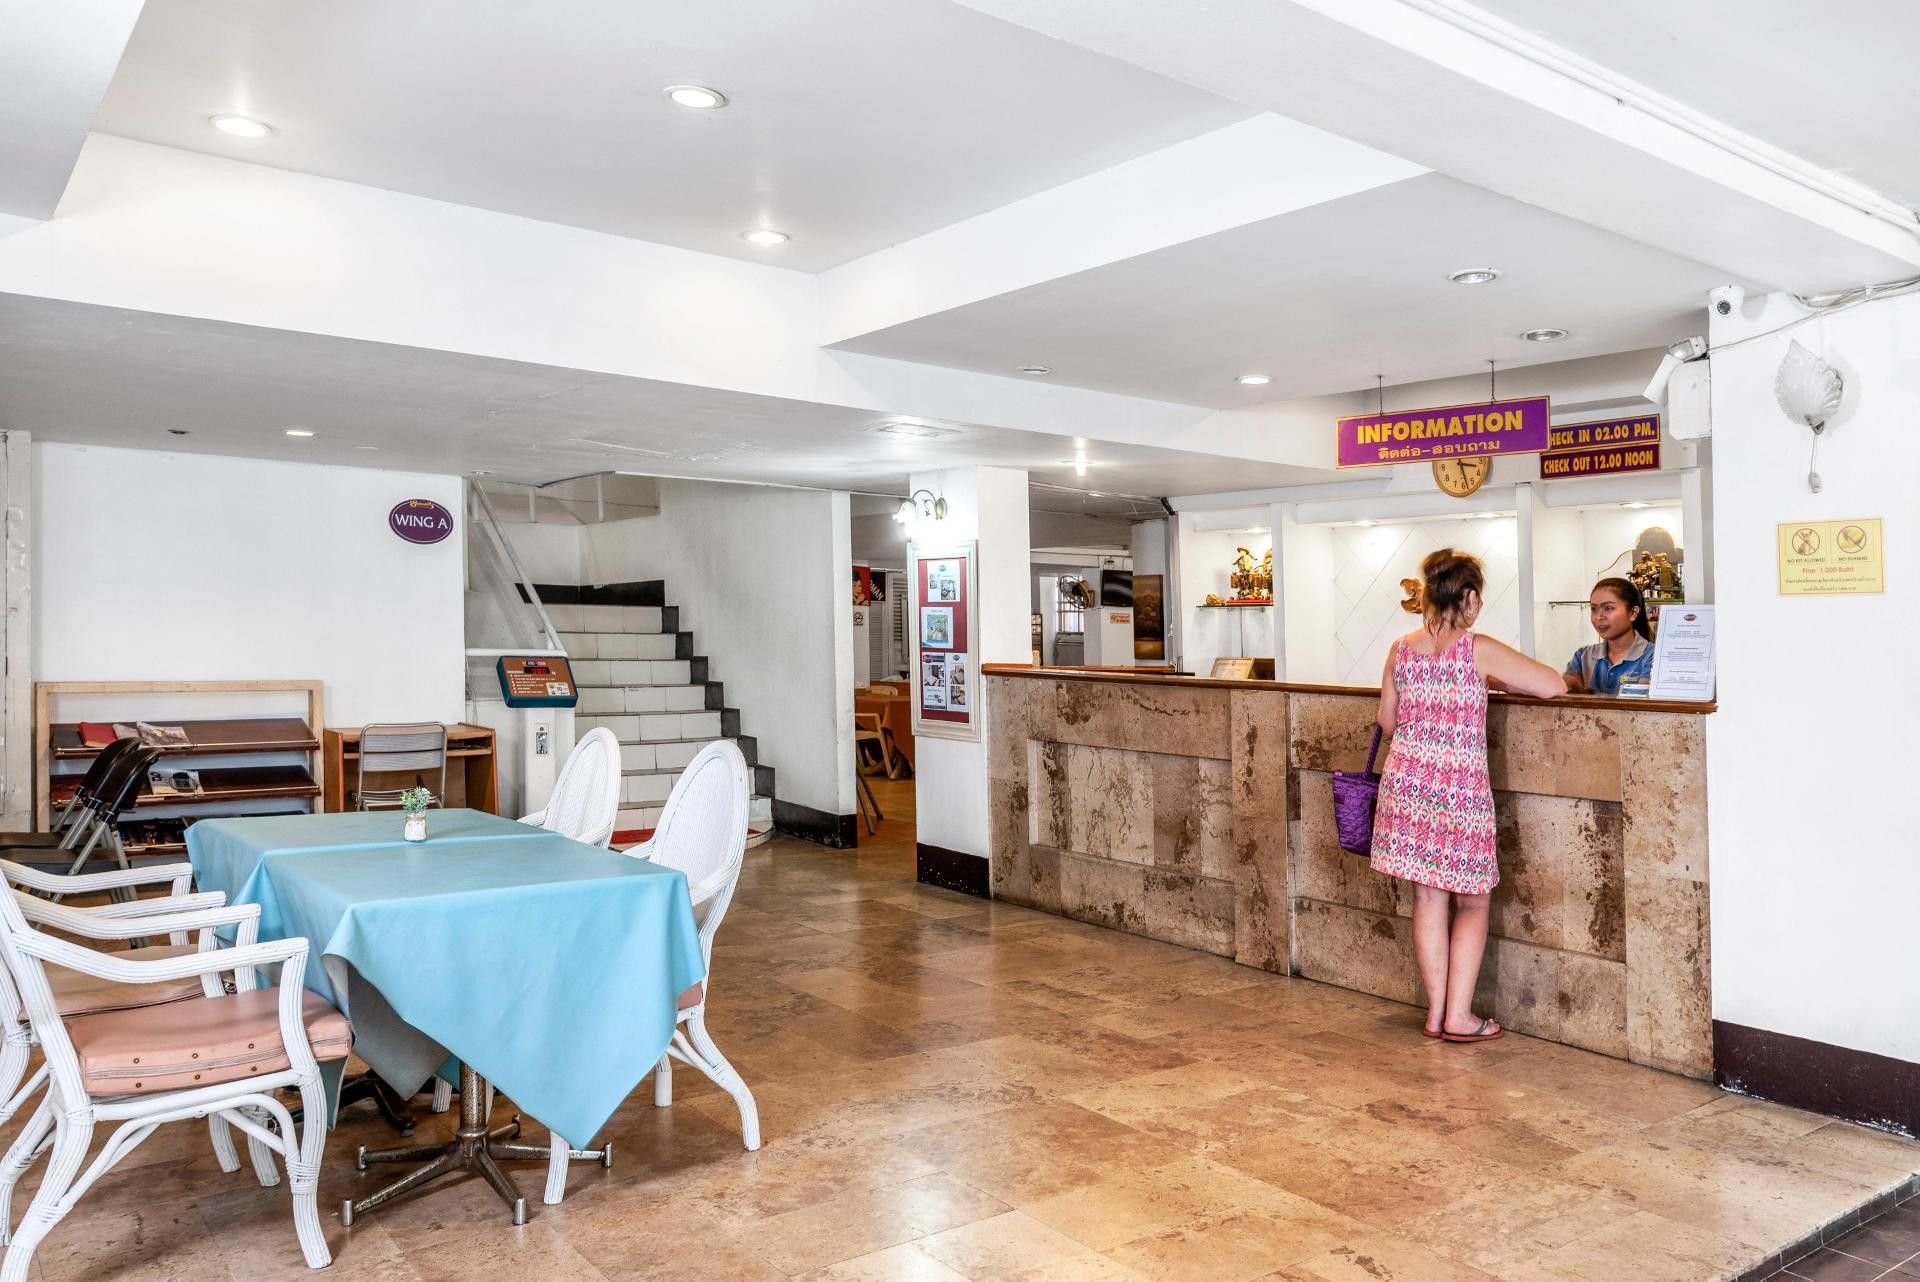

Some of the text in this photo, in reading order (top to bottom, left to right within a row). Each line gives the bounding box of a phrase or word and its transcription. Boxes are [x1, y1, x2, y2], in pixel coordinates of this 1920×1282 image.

[1357, 410, 1523, 445] INFORMATION
[1551, 421, 1656, 446] HECK IN 02.00 PM.
[1543, 450, 1654, 474] CHECK OUT 12.00 NOON
[395, 514, 448, 529] WING A
